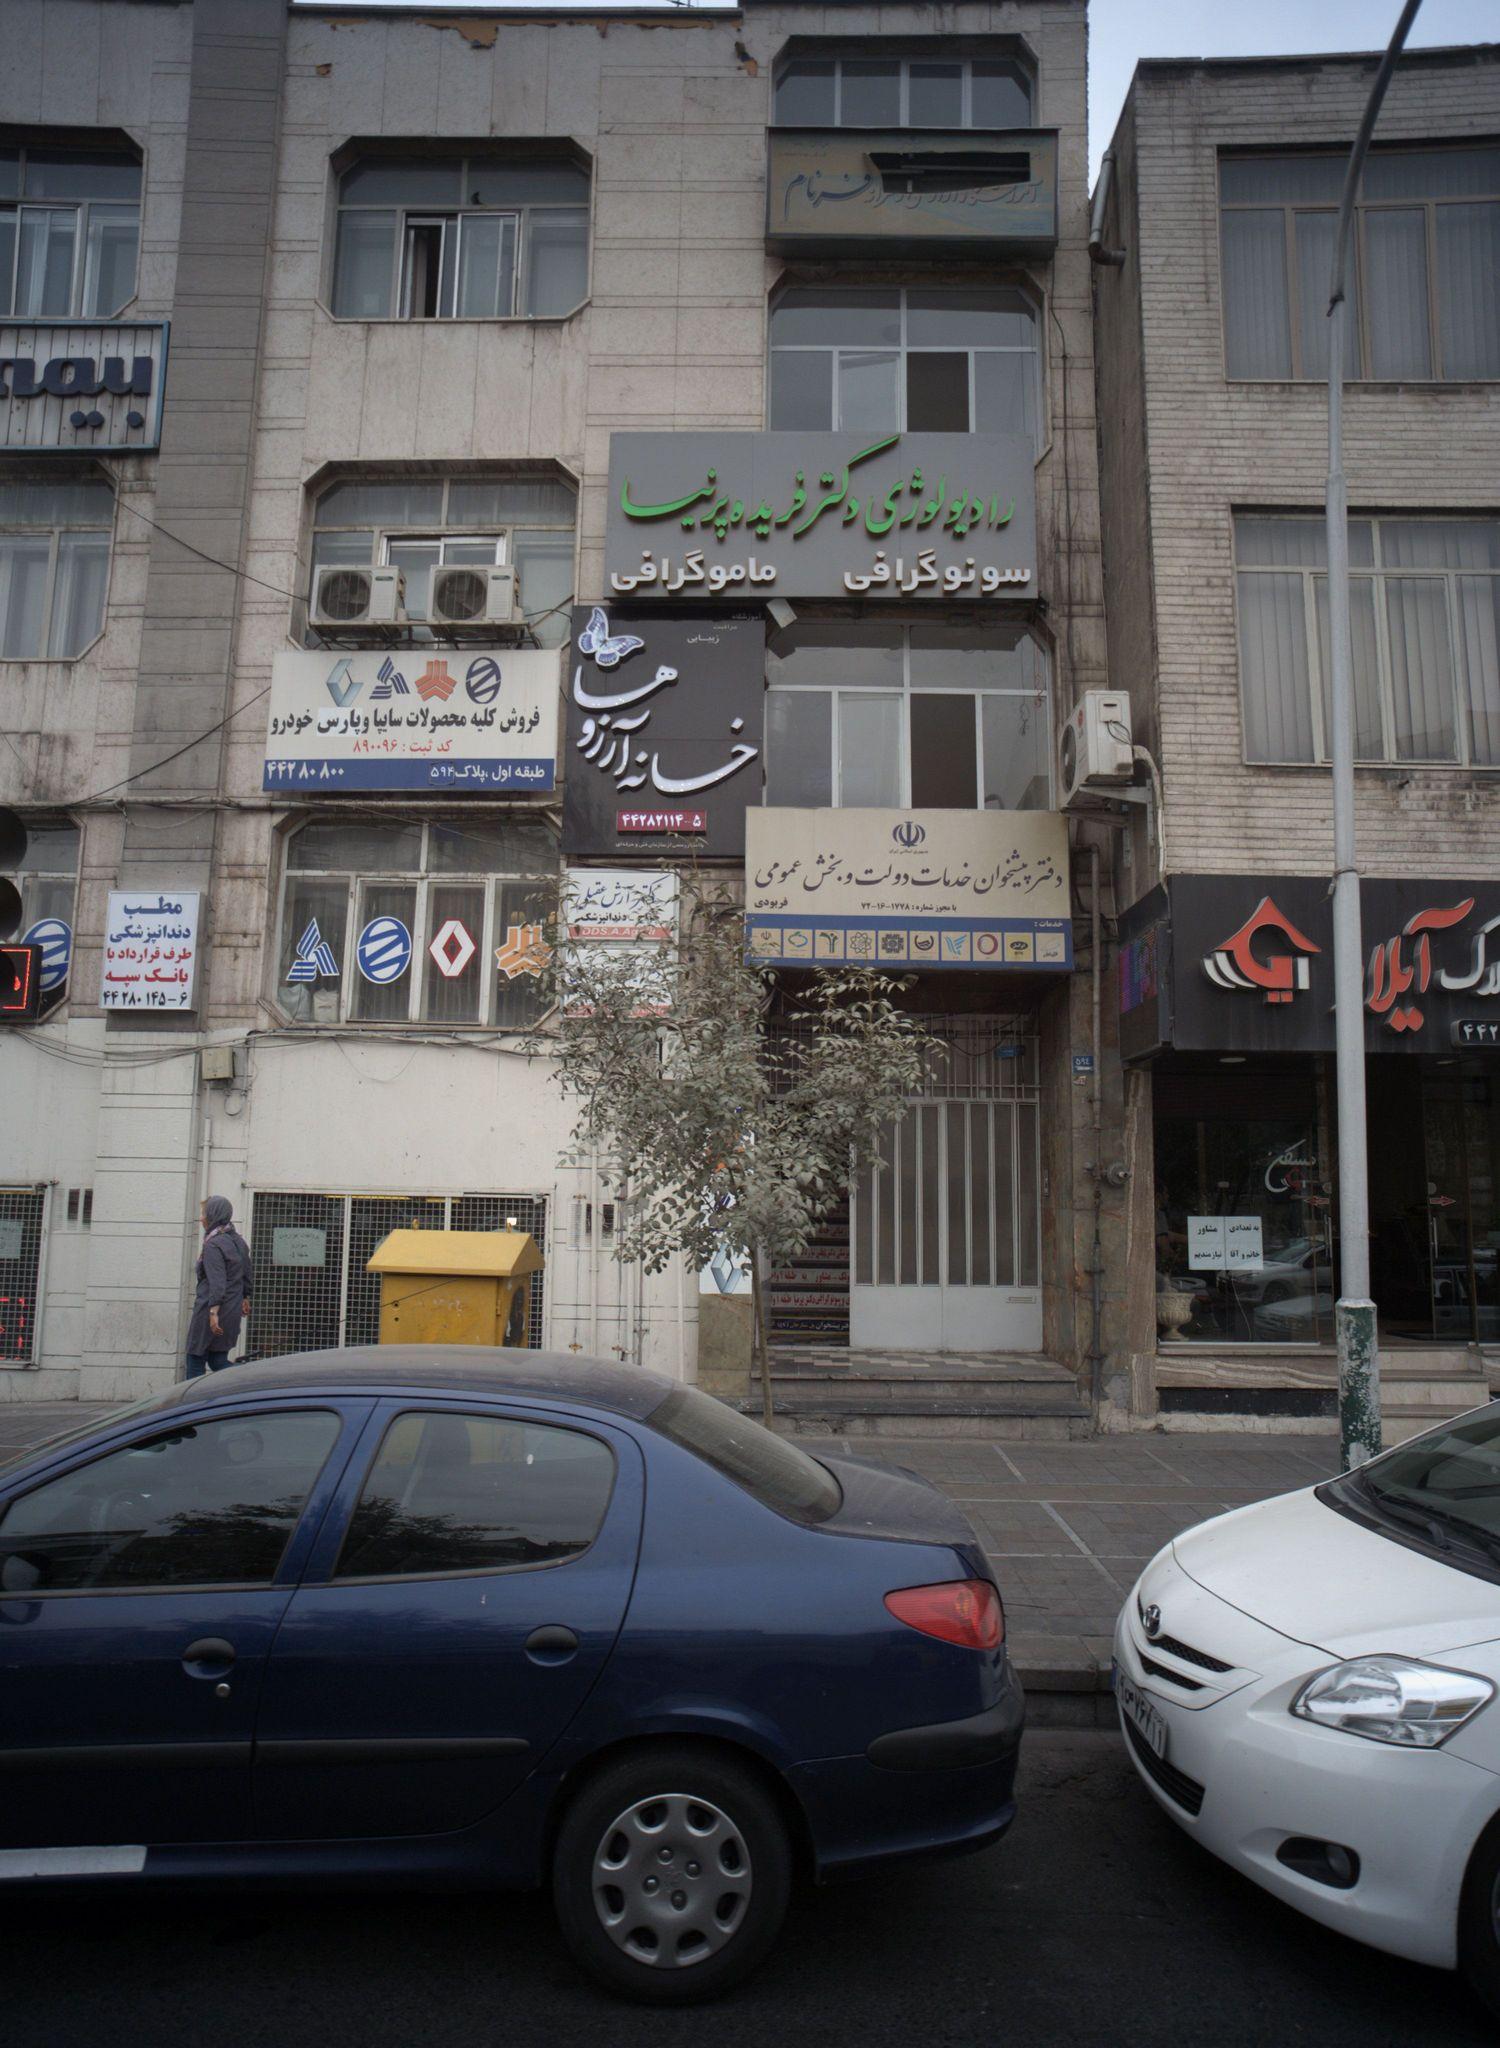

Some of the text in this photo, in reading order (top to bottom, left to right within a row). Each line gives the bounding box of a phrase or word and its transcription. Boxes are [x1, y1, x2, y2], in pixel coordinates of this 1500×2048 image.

[620, 436, 1016, 538] رادیولوژی دکتر فریده پرنیا
[610, 550, 1031, 592] سونوگرافی ماموگرافی
[687, 634, 720, 645] زیبایی
[270, 708, 313, 736] خودرو
[373, 708, 403, 735] سایپا
[406, 708, 467, 734] محصولات
[470, 707, 497, 733] کلیه
[500, 705, 540, 735] فروش
[353, 739, 398, 752] ۸۹۰۰۹۶
[410, 739, 432, 756] ثبت
[437, 739, 453, 752] کد
[492, 765, 512, 781] اول
[515, 766, 545, 781] طبقه
[754, 859, 802, 889] عمومی
[803, 854, 845, 892] بخش
[855, 863, 910, 887] دولت
[911, 862, 972, 888] خدمات
[973, 849, 1031, 894] پیشخوان
[1025, 856, 1063, 894] دفتر
[123, 896, 182, 919] مطب
[109, 925, 191, 944] دندانپزشکی
[106, 946, 192, 963] طرف قرارداد با
[1363, 897, 1476, 1033] آیلا
[105, 968, 189, 988] بانک سپه
[1198, 1224, 1217, 1236] مشاور
